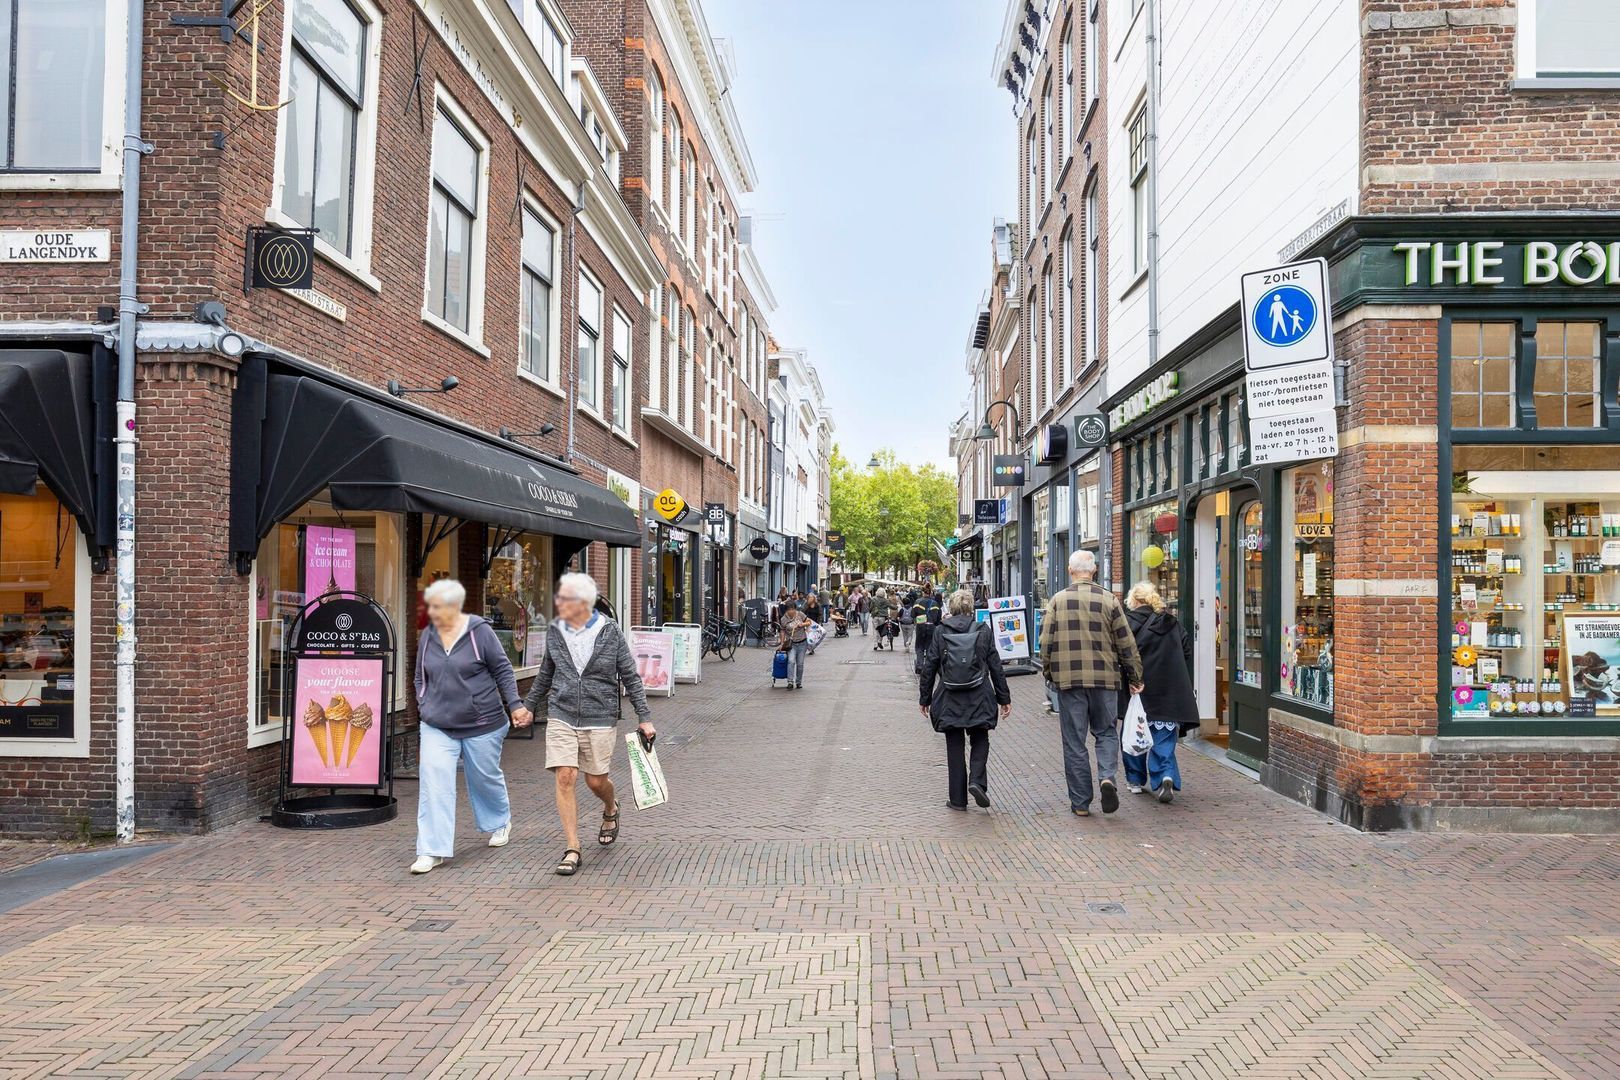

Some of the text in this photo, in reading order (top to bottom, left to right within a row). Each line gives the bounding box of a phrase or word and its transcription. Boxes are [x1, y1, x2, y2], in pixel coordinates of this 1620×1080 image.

[35, 233, 74, 246] OUDE
[9, 246, 98, 259] LANGENDYK
[1393, 241, 1505, 286] THE
[1263, 269, 1300, 285] ZONE
[1249, 378, 1278, 388] fietsen
[1252, 382, 1328, 399] snor-/bromfietsen
[1258, 393, 1324, 408] niet toegestaan
[1269, 416, 1315, 428] toegestaan
[1261, 430, 1283, 439] laden
[1297, 426, 1324, 435] lossen
[1296, 438, 1301, 446] 7
[1303, 437, 1309, 445] h
[1317, 435, 1327, 444] 12
[1329, 434, 1335, 442] h
[1255, 453, 1269, 461] zat
[1297, 449, 1302, 457] 7
[1304, 448, 1310, 456] h
[1318, 446, 1328, 454] 10
[1330, 445, 1336, 453] h
[528, 482, 553, 503] COCO
[676, 510, 687, 522] cash
[1300, 526, 1325, 535] LOVE
[315, 543, 325, 556] ice
[1574, 623, 1584, 631] HET
[307, 631, 338, 641] COCO
[340, 632, 348, 641] &
[1579, 631, 1585, 639] IN
[1586, 631, 1592, 639] JE
[321, 667, 360, 676] CHOOSE
[304, 676, 374, 689] your flavour
